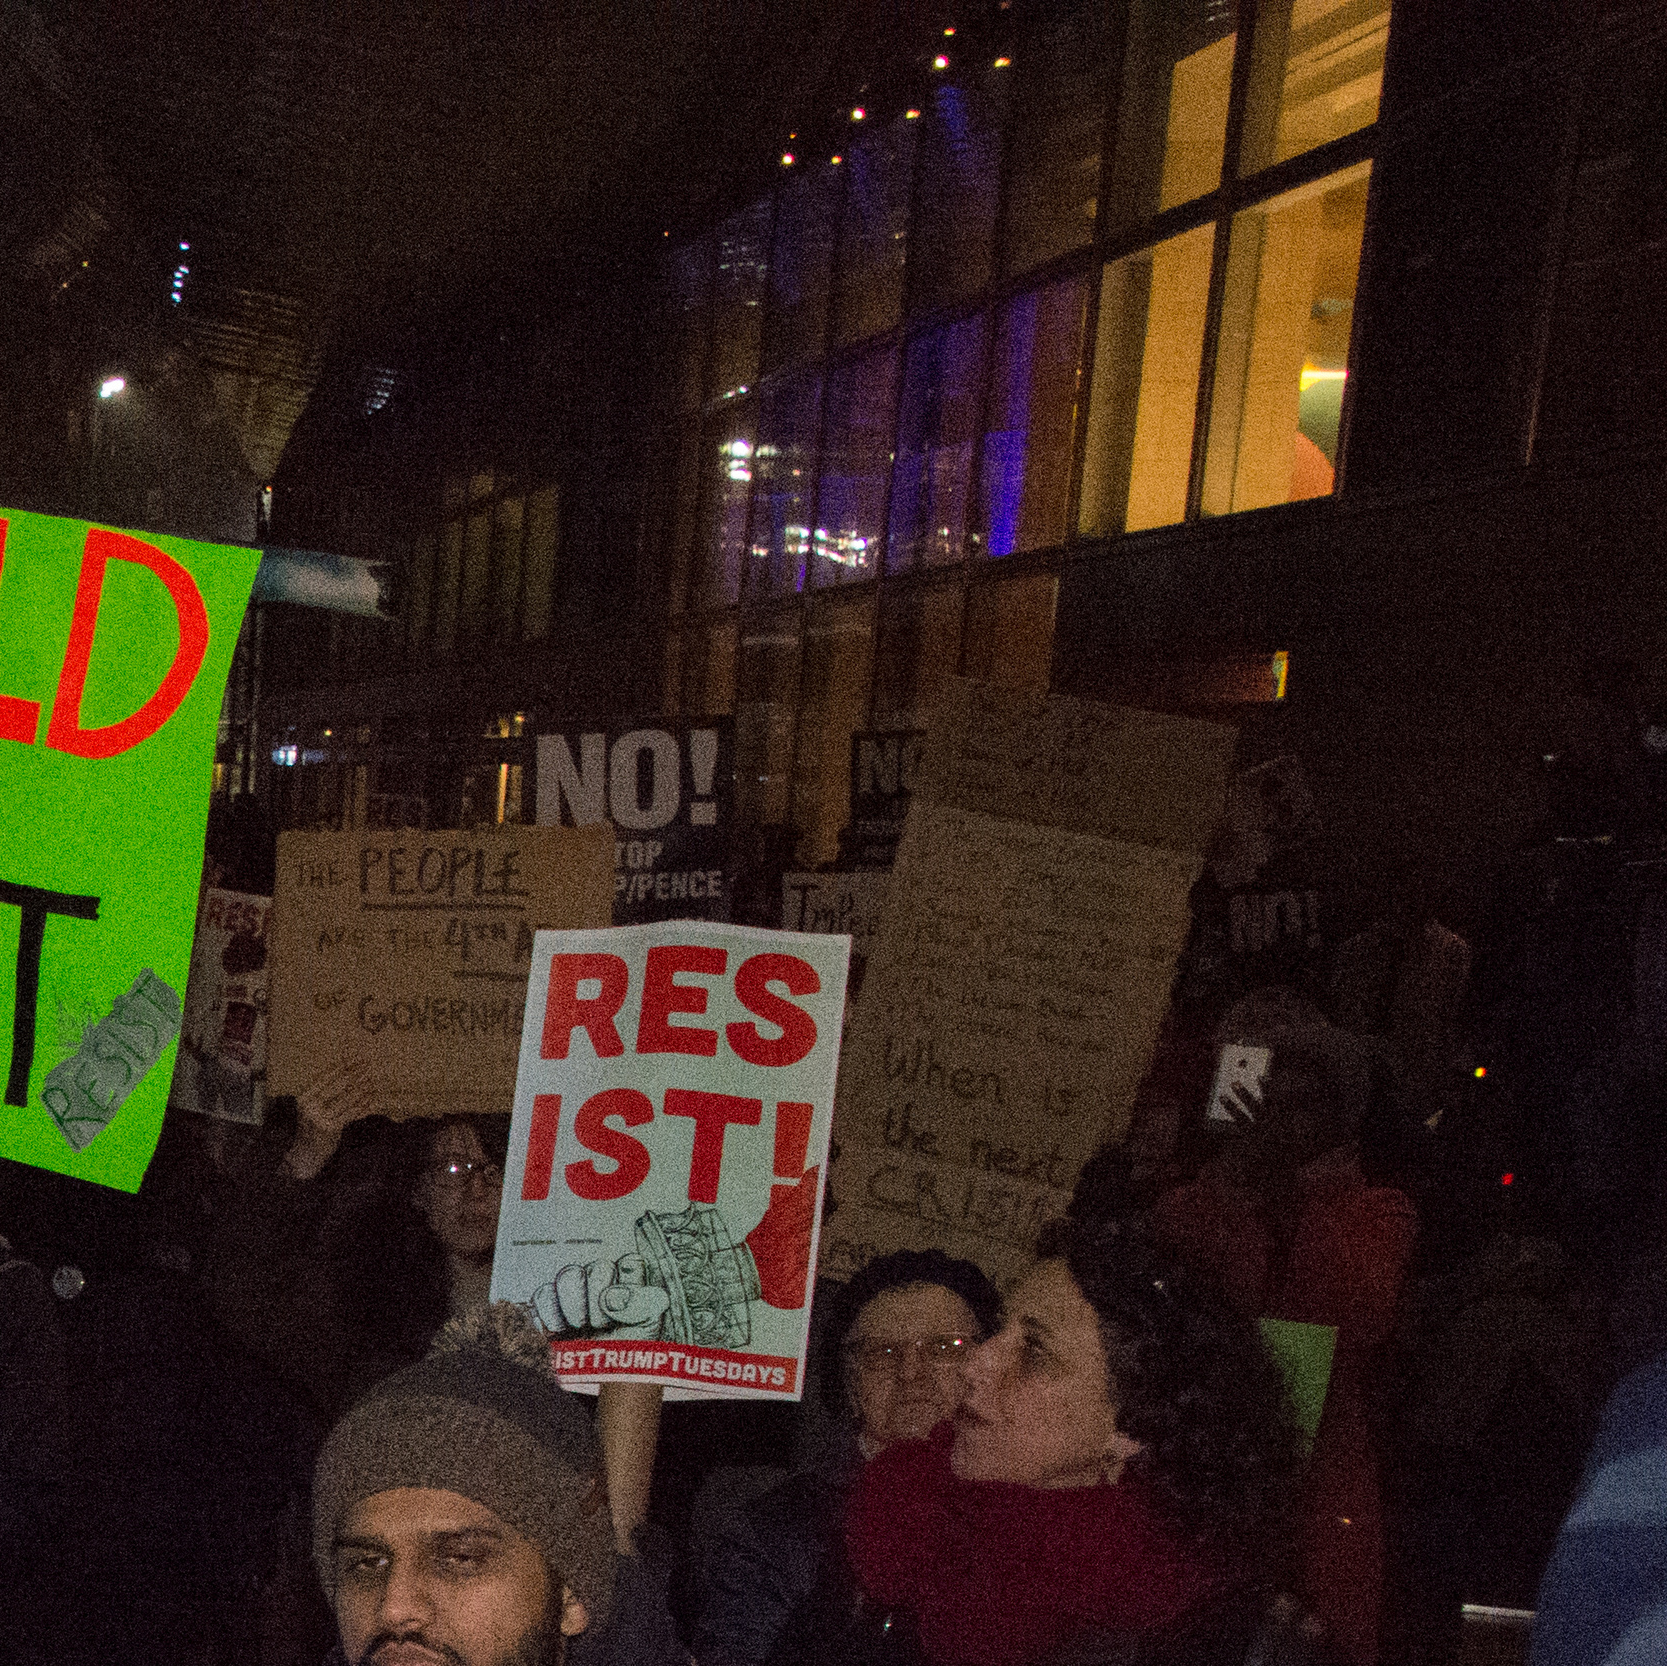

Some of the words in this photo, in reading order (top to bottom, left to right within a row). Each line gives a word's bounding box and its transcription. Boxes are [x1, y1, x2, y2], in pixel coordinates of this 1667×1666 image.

[535, 728, 720, 831] NO!
[359, 848, 529, 897] PEOPLE
[614, 841, 663, 868] TOP
[614, 870, 723, 903] P/PENCE
[540, 945, 821, 1067] RES
[884, 1034, 1003, 1105] When
[521, 1088, 815, 1203] IST!
[554, 1347, 786, 1386] ISTTRUMPTUESDAYS
